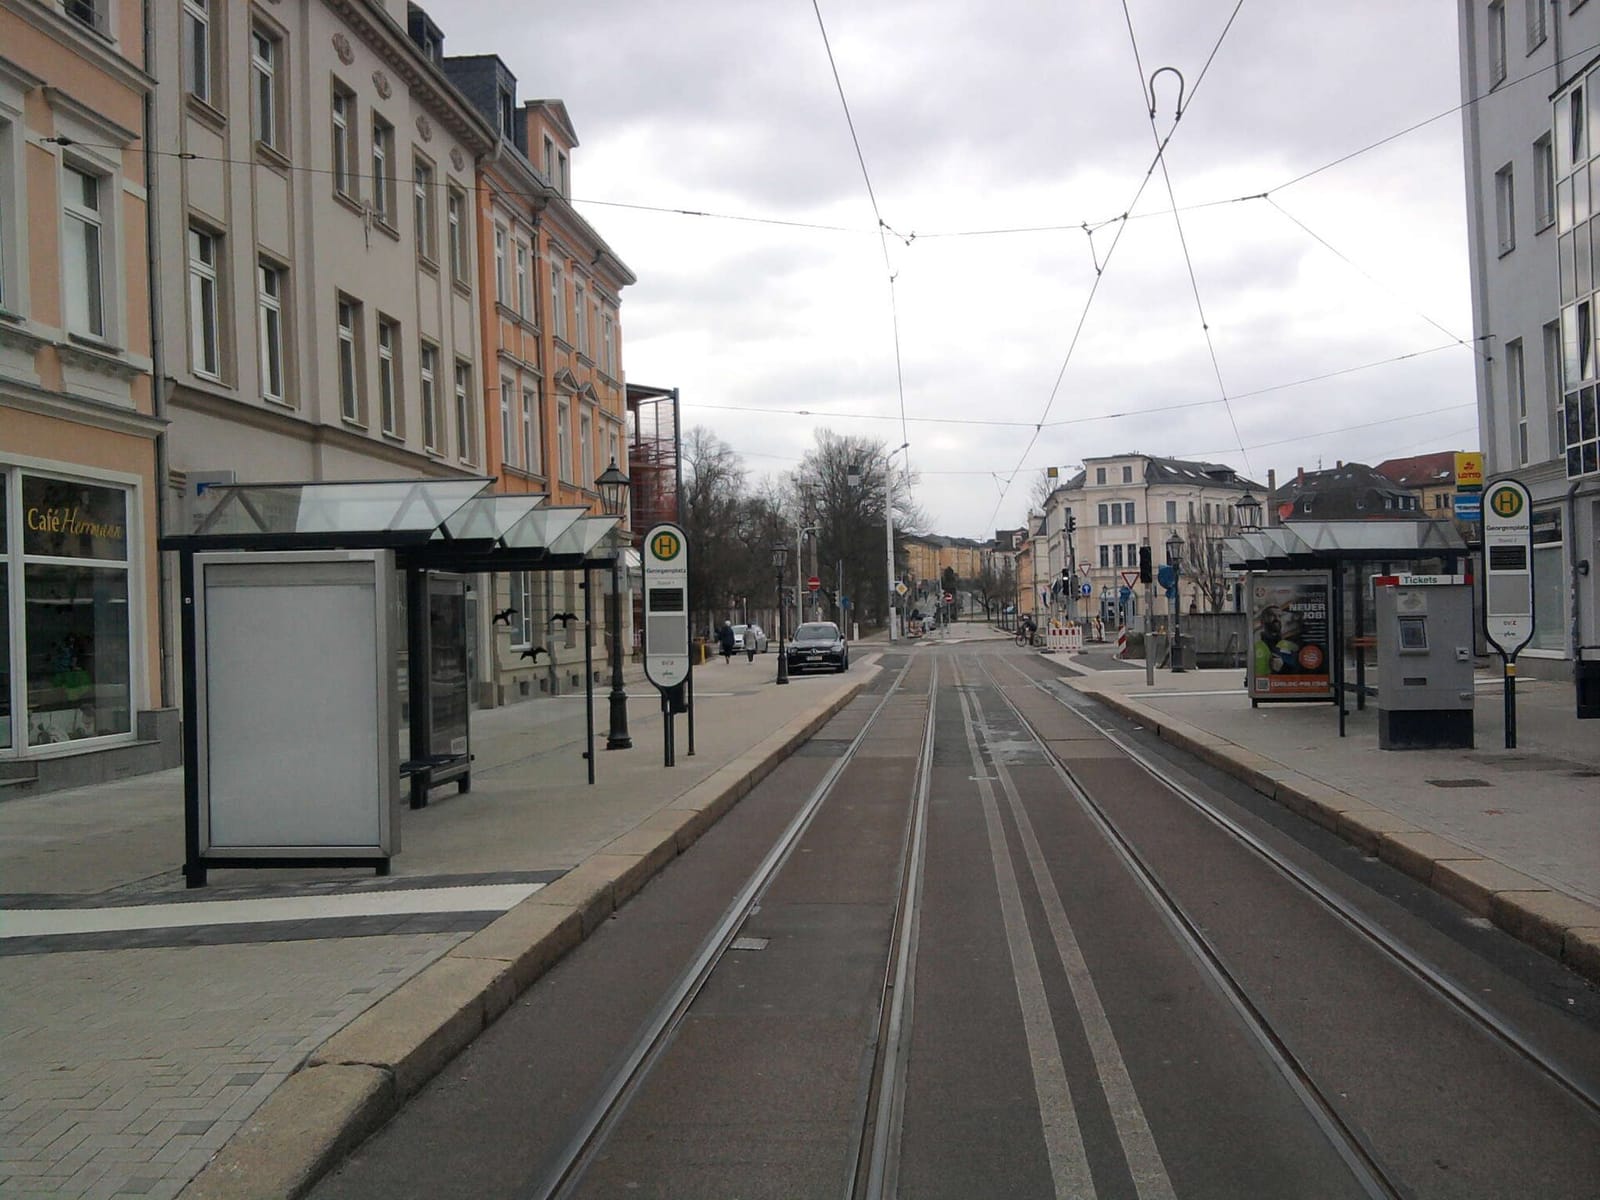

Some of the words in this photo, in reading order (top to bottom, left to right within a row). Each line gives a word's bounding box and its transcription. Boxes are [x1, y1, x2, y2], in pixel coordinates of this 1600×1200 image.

[1499, 493, 1513, 511] H
[27, 507, 60, 532] Café
[659, 537, 672, 555] H
[1403, 576, 1438, 584] Tickets
[1289, 603, 1326, 611] NEUER
